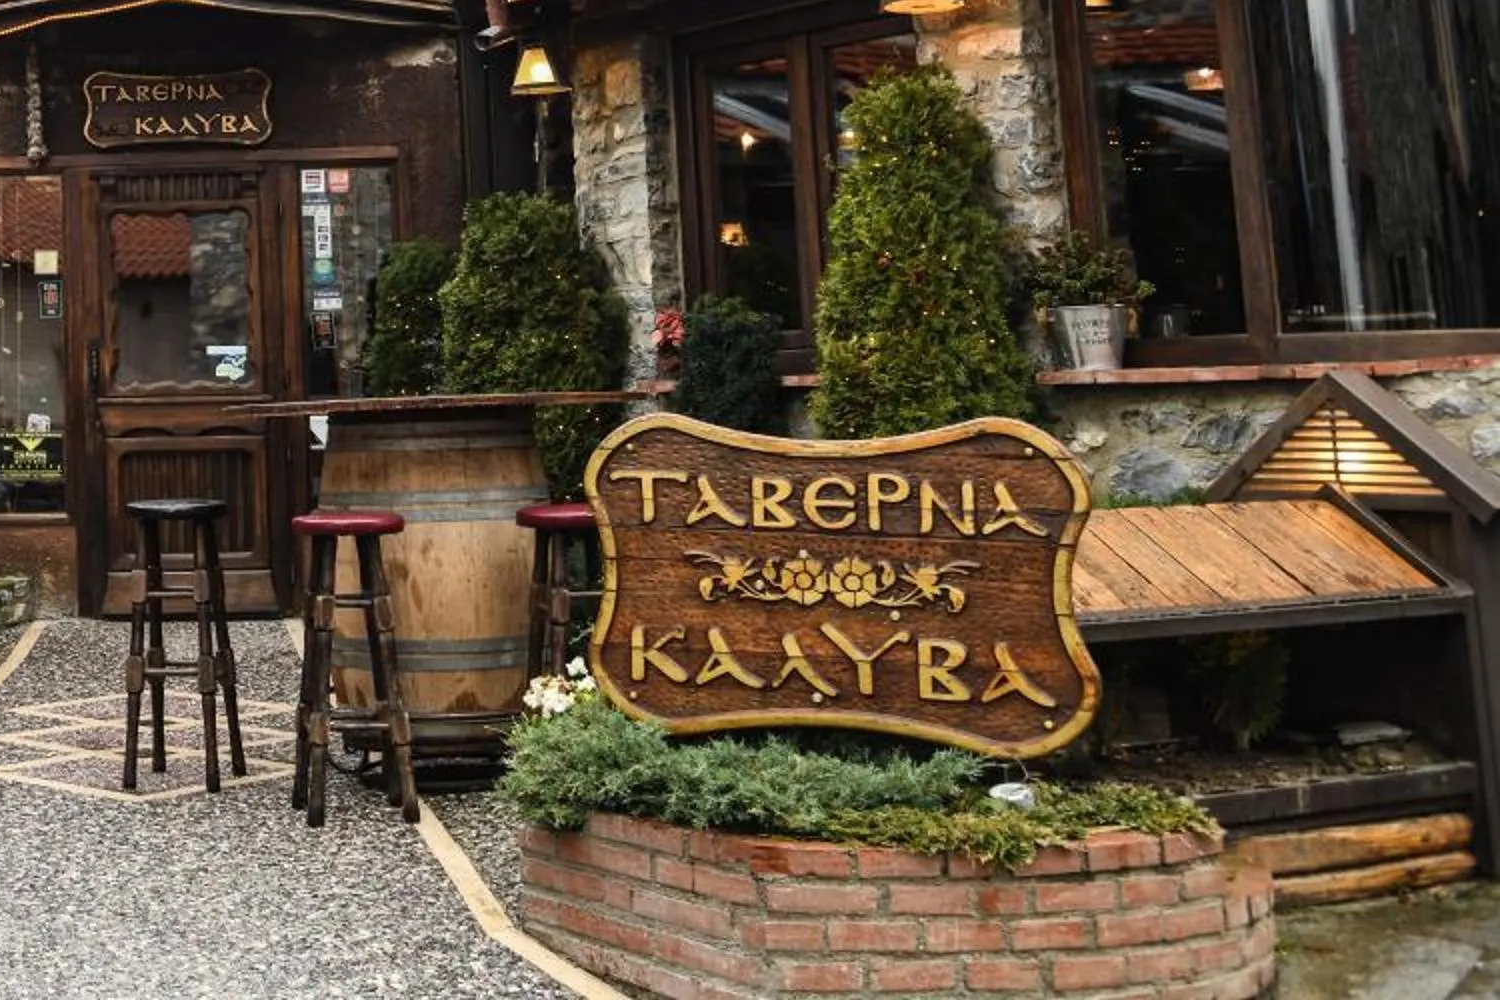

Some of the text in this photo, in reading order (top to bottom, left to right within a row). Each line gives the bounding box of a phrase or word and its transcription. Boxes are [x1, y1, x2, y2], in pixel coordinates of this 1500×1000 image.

[92, 82, 224, 102] ΤΑΒΕΡΝΑ
[135, 113, 261, 135] ΚΑΛΥΒΑ
[610, 470, 1049, 537] ΤΑΒΕΡΝΑ
[630, 622, 1056, 707] ΚΑΛΥΒΑ
